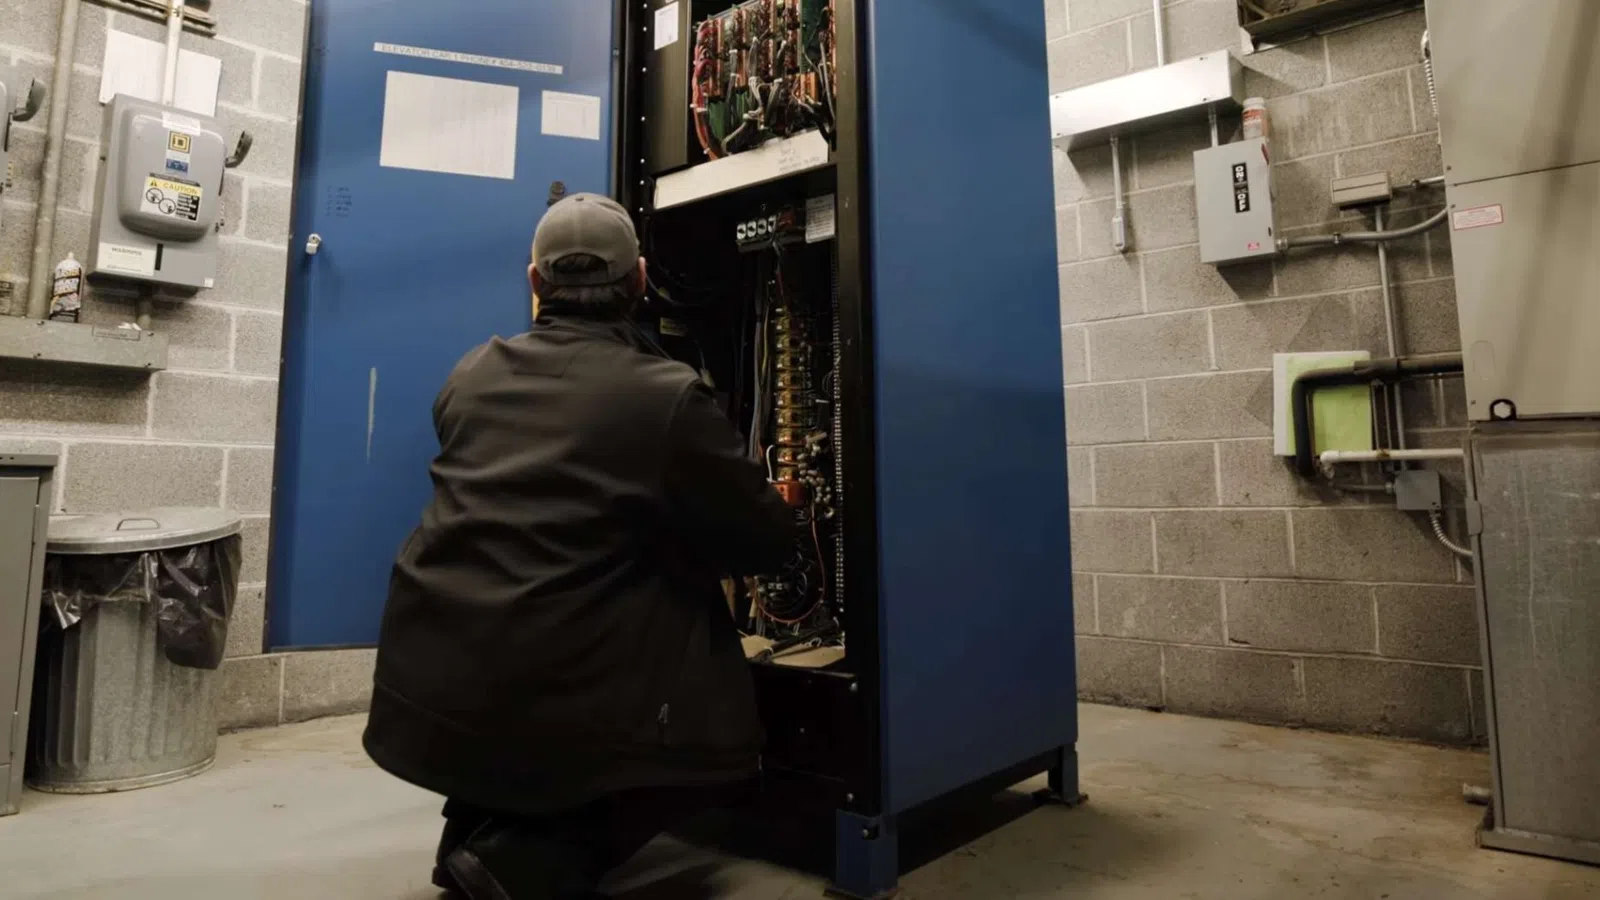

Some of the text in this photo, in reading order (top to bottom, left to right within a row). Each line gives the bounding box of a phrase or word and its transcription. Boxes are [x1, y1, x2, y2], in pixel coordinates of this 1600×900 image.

[381, 44, 429, 57] ELEVATOR
[1235, 166, 1244, 178] ON
[163, 181, 198, 195] CAUTION
